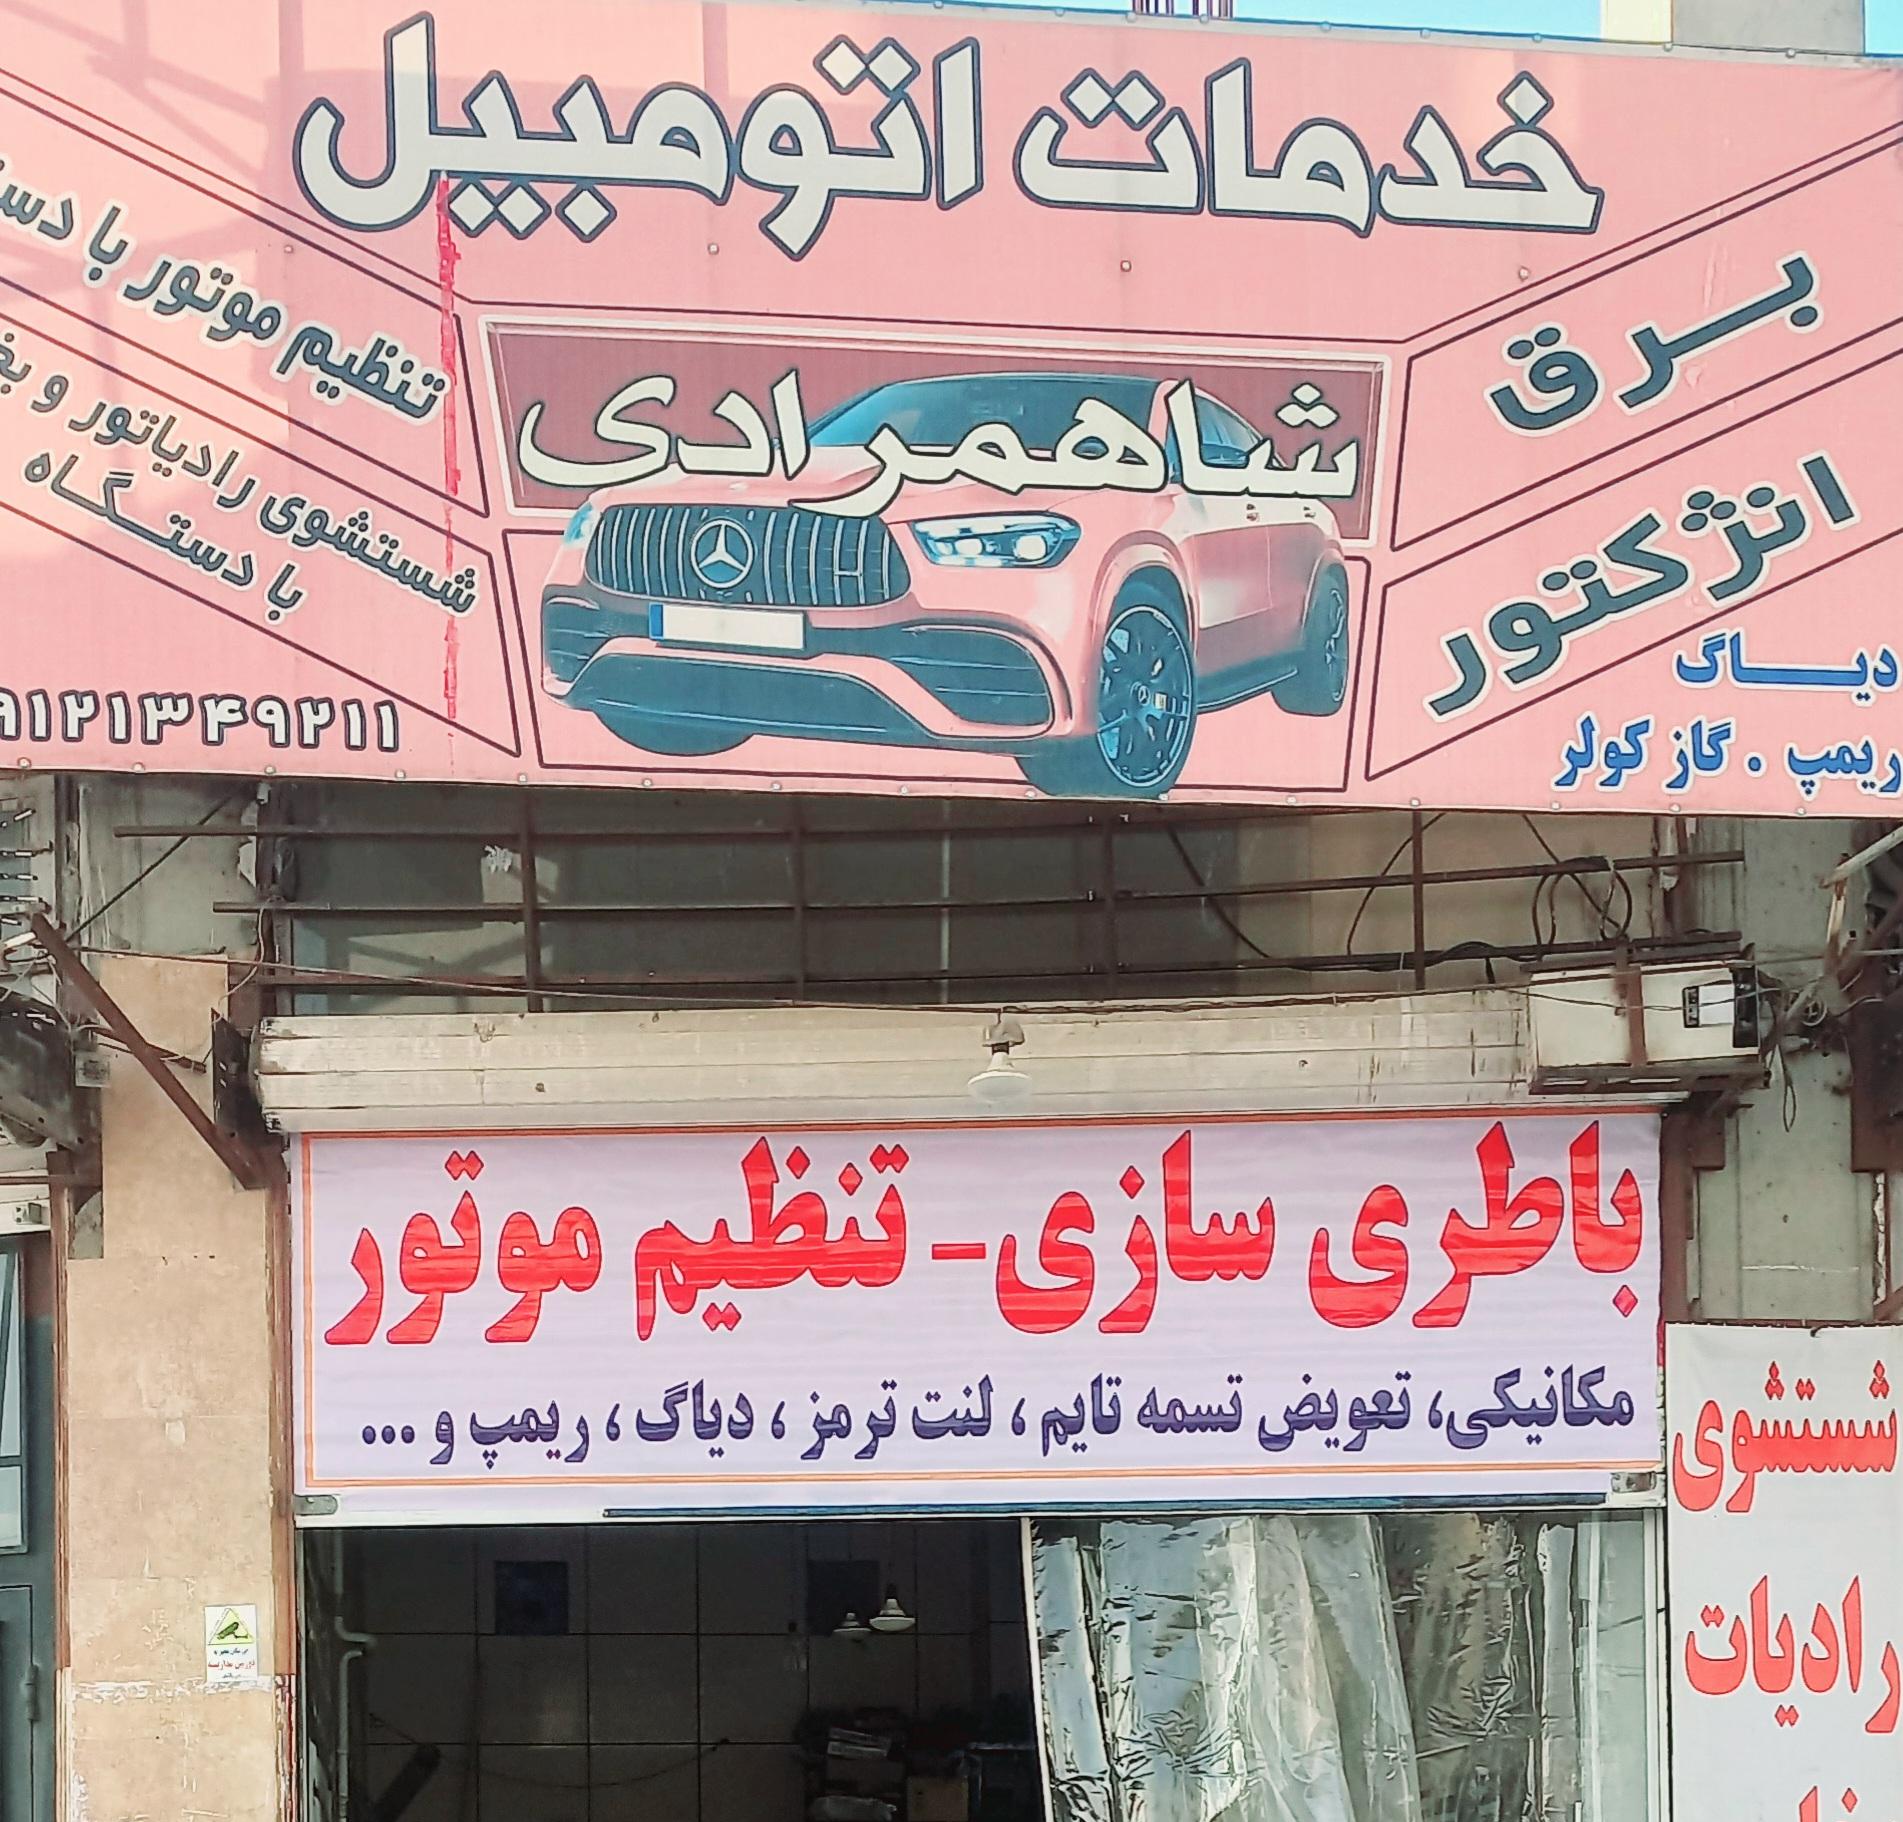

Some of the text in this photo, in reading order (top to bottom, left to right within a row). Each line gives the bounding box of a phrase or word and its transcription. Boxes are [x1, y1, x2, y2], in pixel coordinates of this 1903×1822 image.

[293, 11, 1604, 260] خدمات اتومبیل
[88, 206, 128, 281] با
[123, 258, 282, 342] موتور
[1490, 256, 1816, 431] برق
[31, 375, 69, 413] و
[278, 321, 449, 425] تنظیم
[69, 402, 256, 513] رادیاتور
[24, 453, 308, 622] با دستگاه
[260, 490, 475, 616] شستشوی
[1427, 456, 1856, 713] انژکتور
[1677, 632, 1897, 701] دیاگ
[1555, 716, 1650, 786] کولر
[1666, 720, 1731, 788] گاز
[1788, 740, 1902, 796] ریمپ
[324, 1150, 602, 1344] موتور
[635, 1137, 909, 1340] تنظیم
[996, 1130, 1274, 1333] سازی
[1308, 1121, 1642, 1328] باطری
[471, 1401, 590, 1468] ریمپ
[912, 1375, 992, 1437] لنت
[1137, 1374, 1242, 1434] تسمه
[1259, 1372, 1411, 1451] تعویض
[1673, 1361, 1897, 1512] شستشوی
[1686, 1575, 1900, 1733] رادیات
